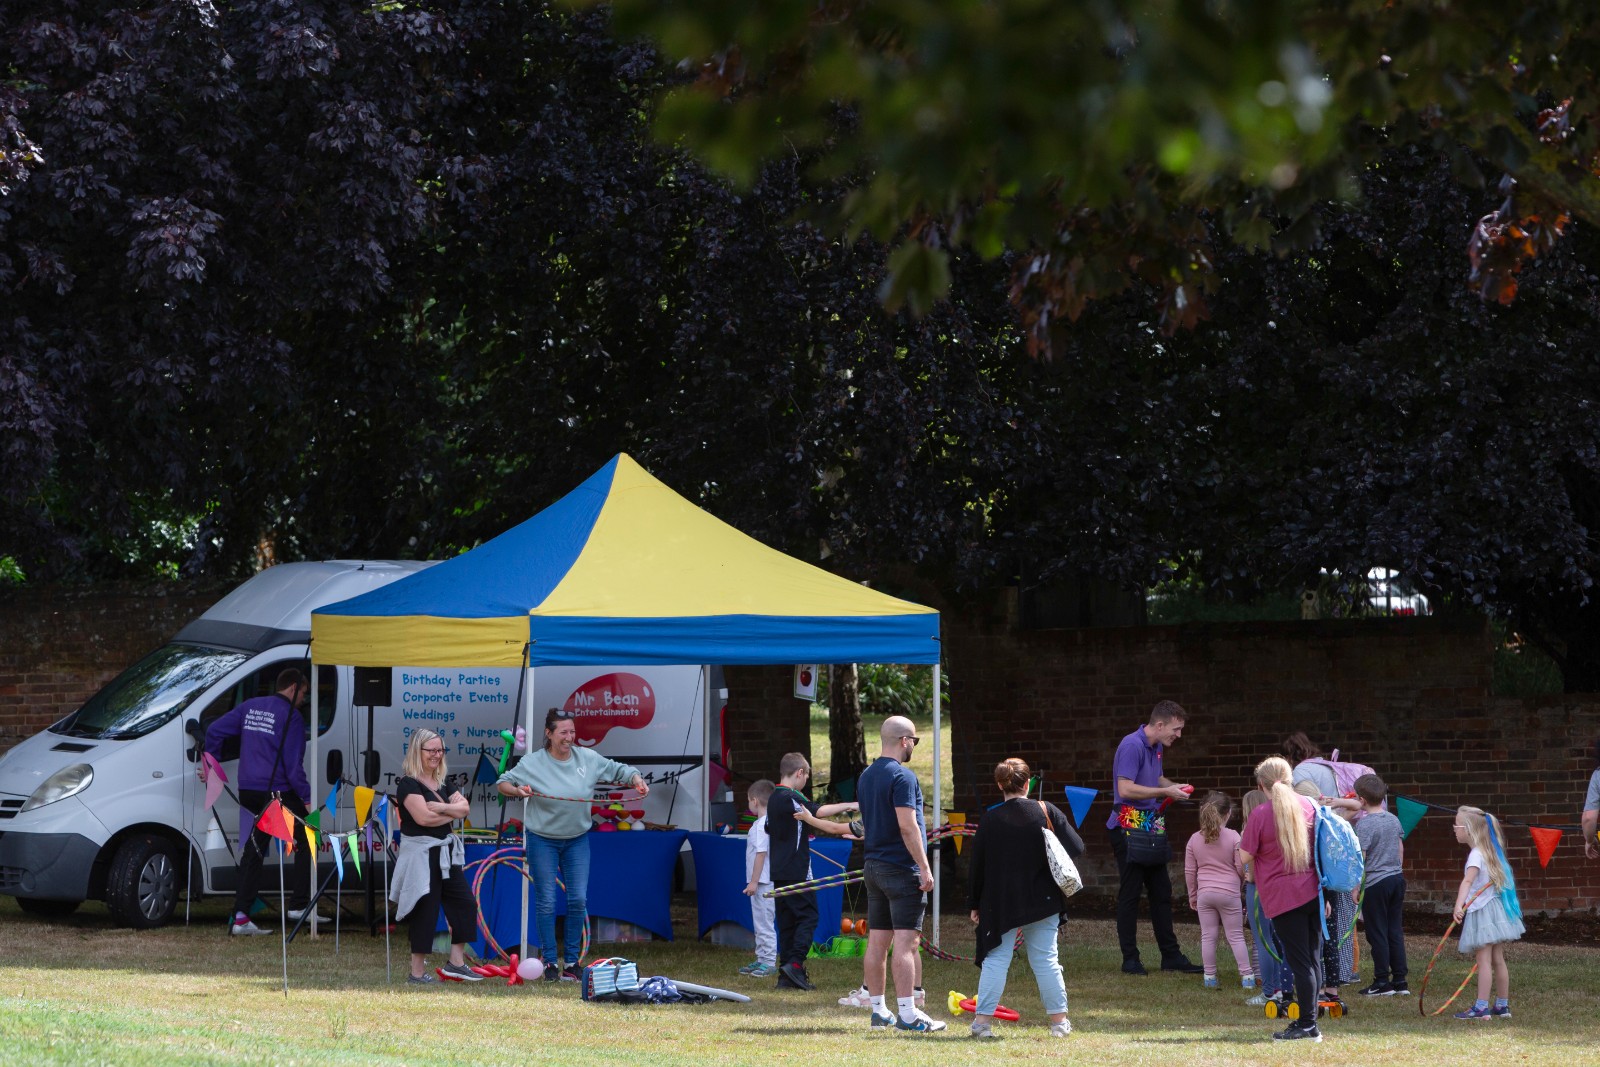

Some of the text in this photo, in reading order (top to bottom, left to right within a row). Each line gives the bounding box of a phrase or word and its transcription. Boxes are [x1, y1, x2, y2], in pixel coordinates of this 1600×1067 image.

[402, 673, 501, 688] Birthday Parties
[402, 691, 509, 705] Corporate Events
[574, 691, 640, 706] Mr Bean
[402, 708, 456, 723] Weddings
[574, 707, 640, 718] Entertainments
[383, 772, 401, 786] Te
